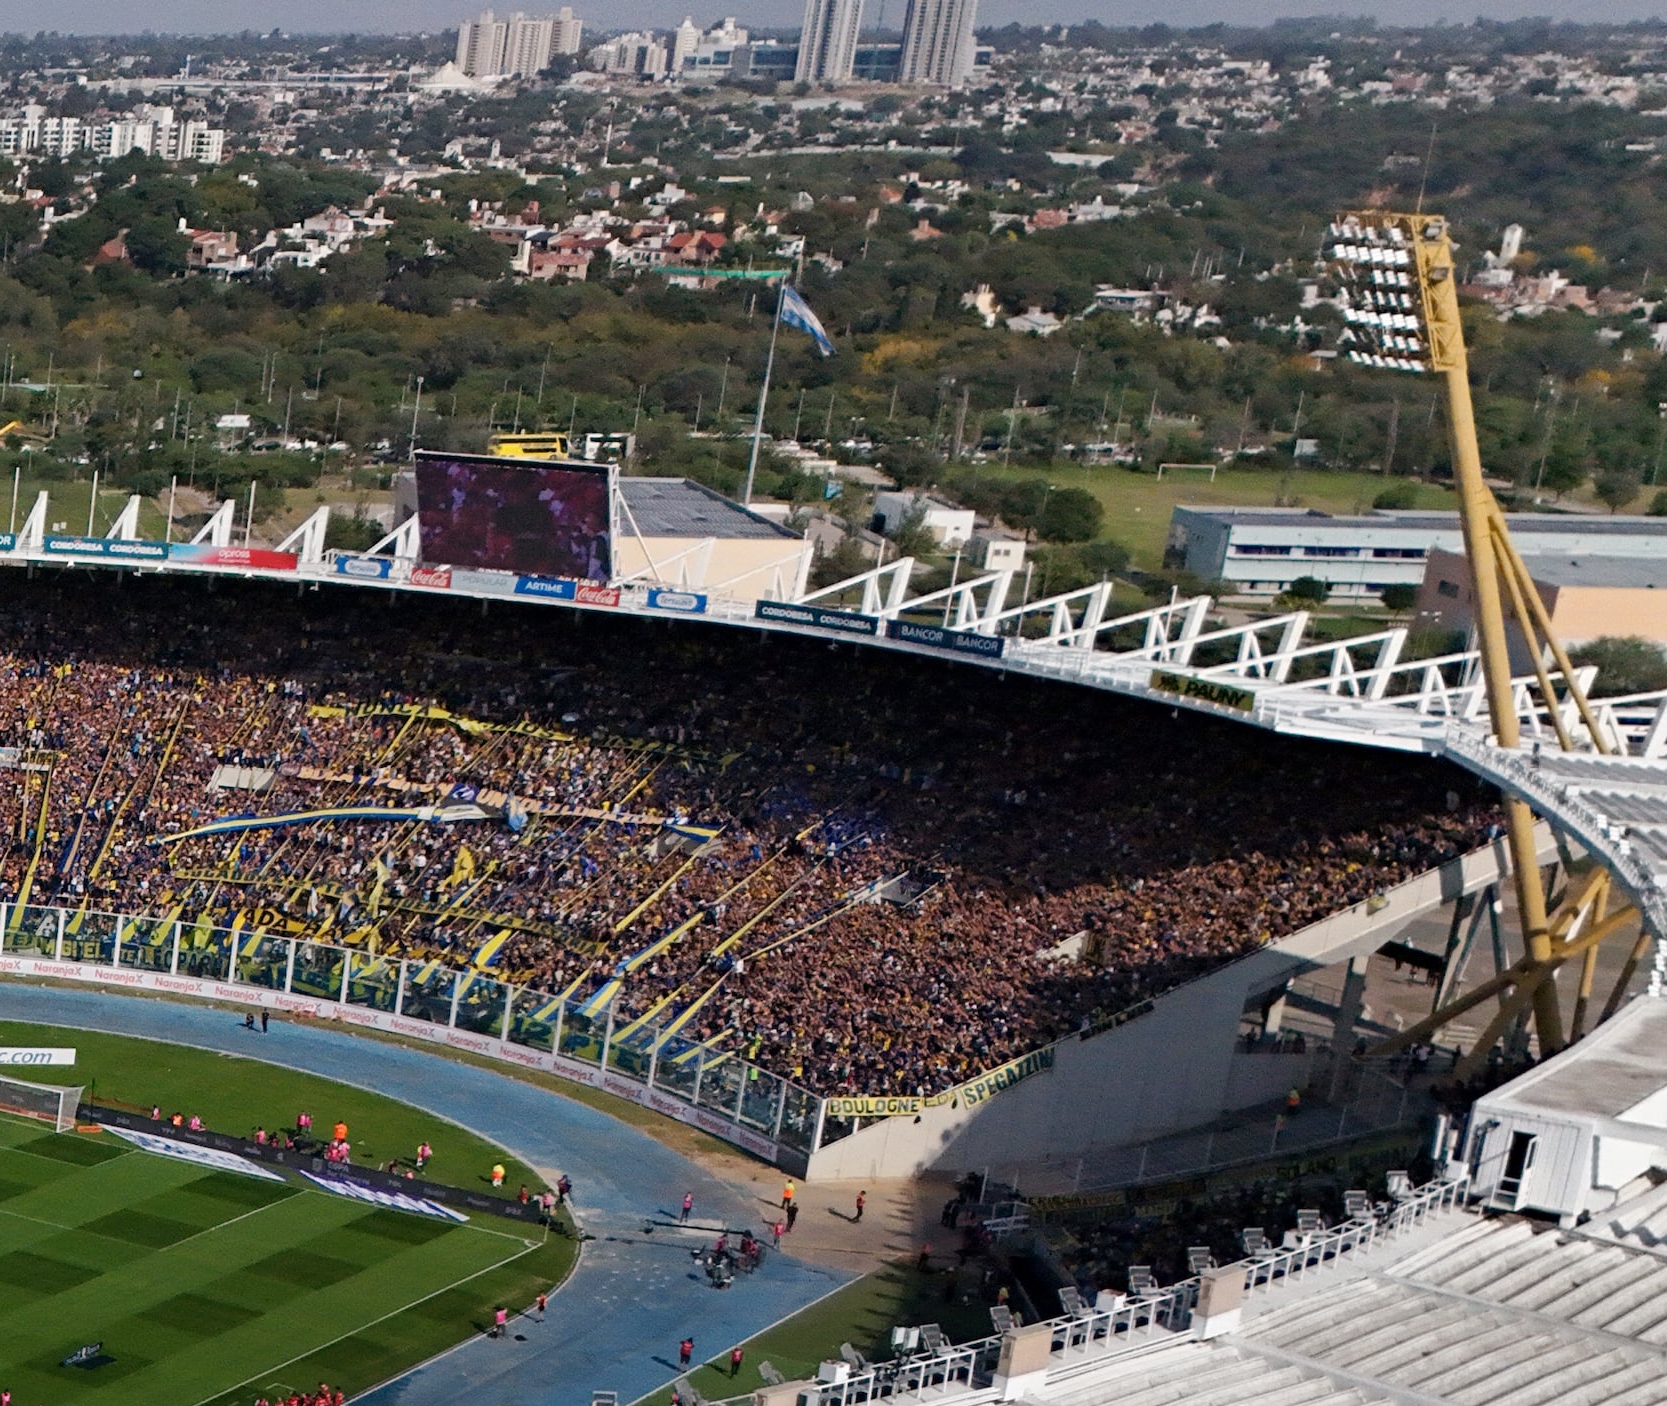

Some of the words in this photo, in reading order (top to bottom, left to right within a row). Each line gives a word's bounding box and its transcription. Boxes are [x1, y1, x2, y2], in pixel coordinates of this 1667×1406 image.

[50, 541, 103, 551] CORDOBESA
[110, 544, 164, 555] CORDOBESA
[461, 574, 508, 586] POPULAR
[525, 581, 563, 593] ARTIME
[762, 606, 814, 621] CORDOBESA
[820, 615, 871, 630] CORDOBESA
[901, 625, 944, 642] BANCOR
[956, 635, 998, 651] BANCOR
[1185, 681, 1246, 706] PAUNY
[964, 1047, 1055, 1105] SPEGAZZINI
[830, 1098, 919, 1114] BOULOGNE
